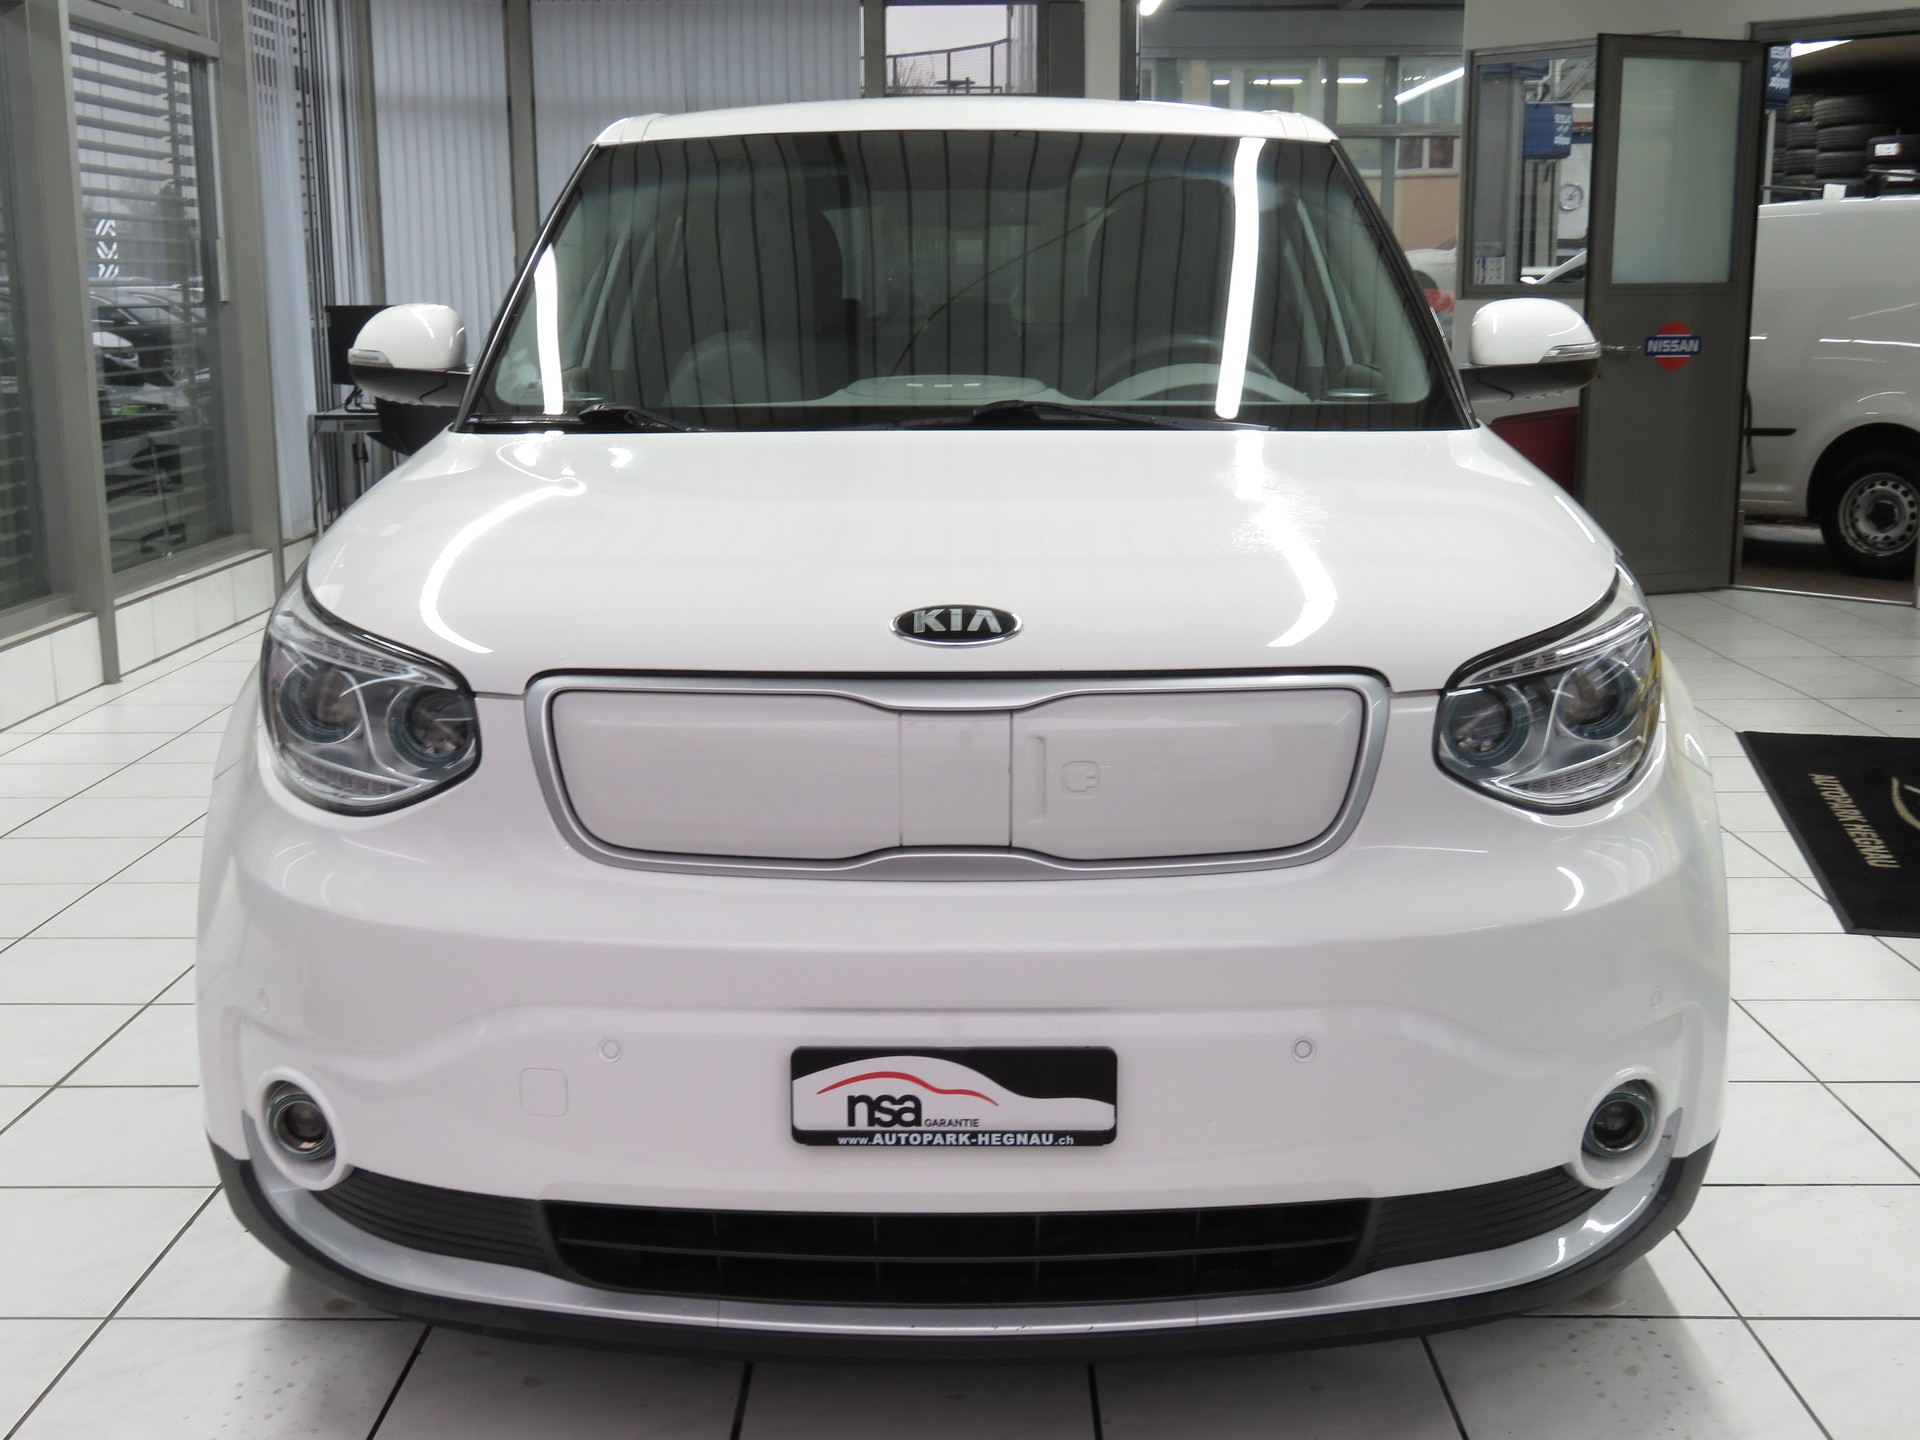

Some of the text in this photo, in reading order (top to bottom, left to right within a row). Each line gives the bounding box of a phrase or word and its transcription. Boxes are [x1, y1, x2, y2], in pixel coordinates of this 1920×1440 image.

[1646, 339, 1700, 353] NISSAN
[912, 608, 1003, 634] KIA
[1807, 772, 1902, 869] AUTOPARK HEGNAU
[846, 1093, 980, 1128] nsa GARANTIE
[836, 1132, 1075, 1147] www.AUTOPARK-HEGNAU.ch
